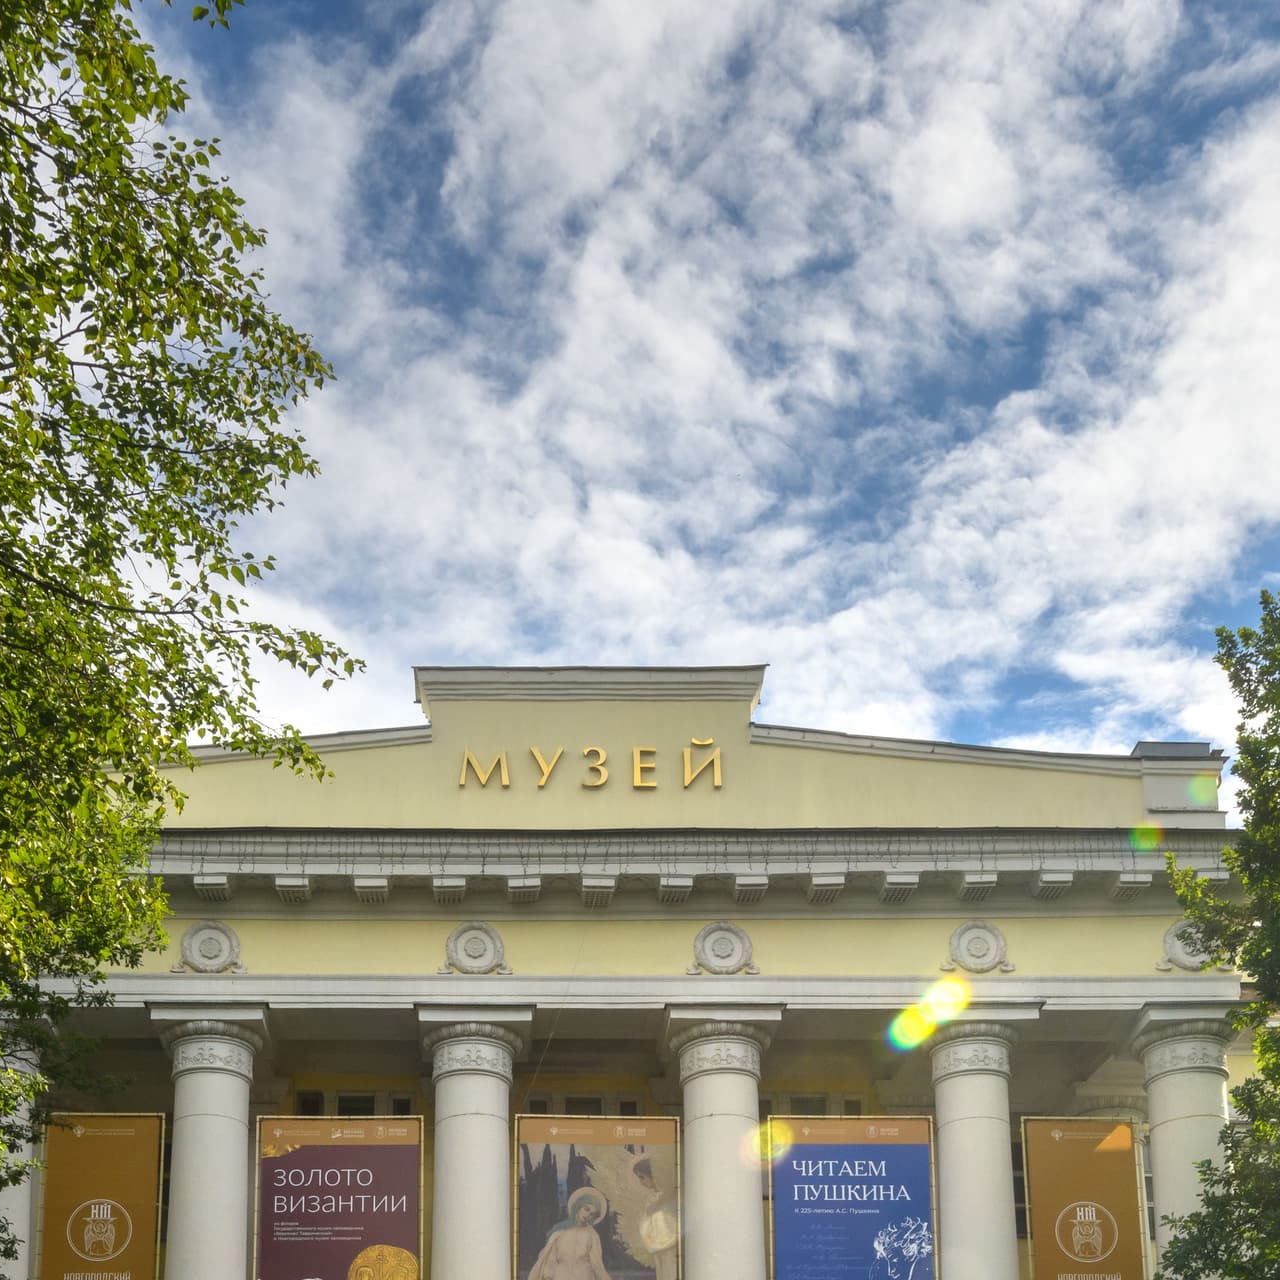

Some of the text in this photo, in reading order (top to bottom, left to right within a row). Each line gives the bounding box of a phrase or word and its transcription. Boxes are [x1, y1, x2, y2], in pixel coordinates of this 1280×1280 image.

[458, 737, 723, 789] МУЗЕЙ
[792, 1160, 887, 1177] ЧИТАЕМ
[793, 1184, 911, 1201] ПУШКИНА
